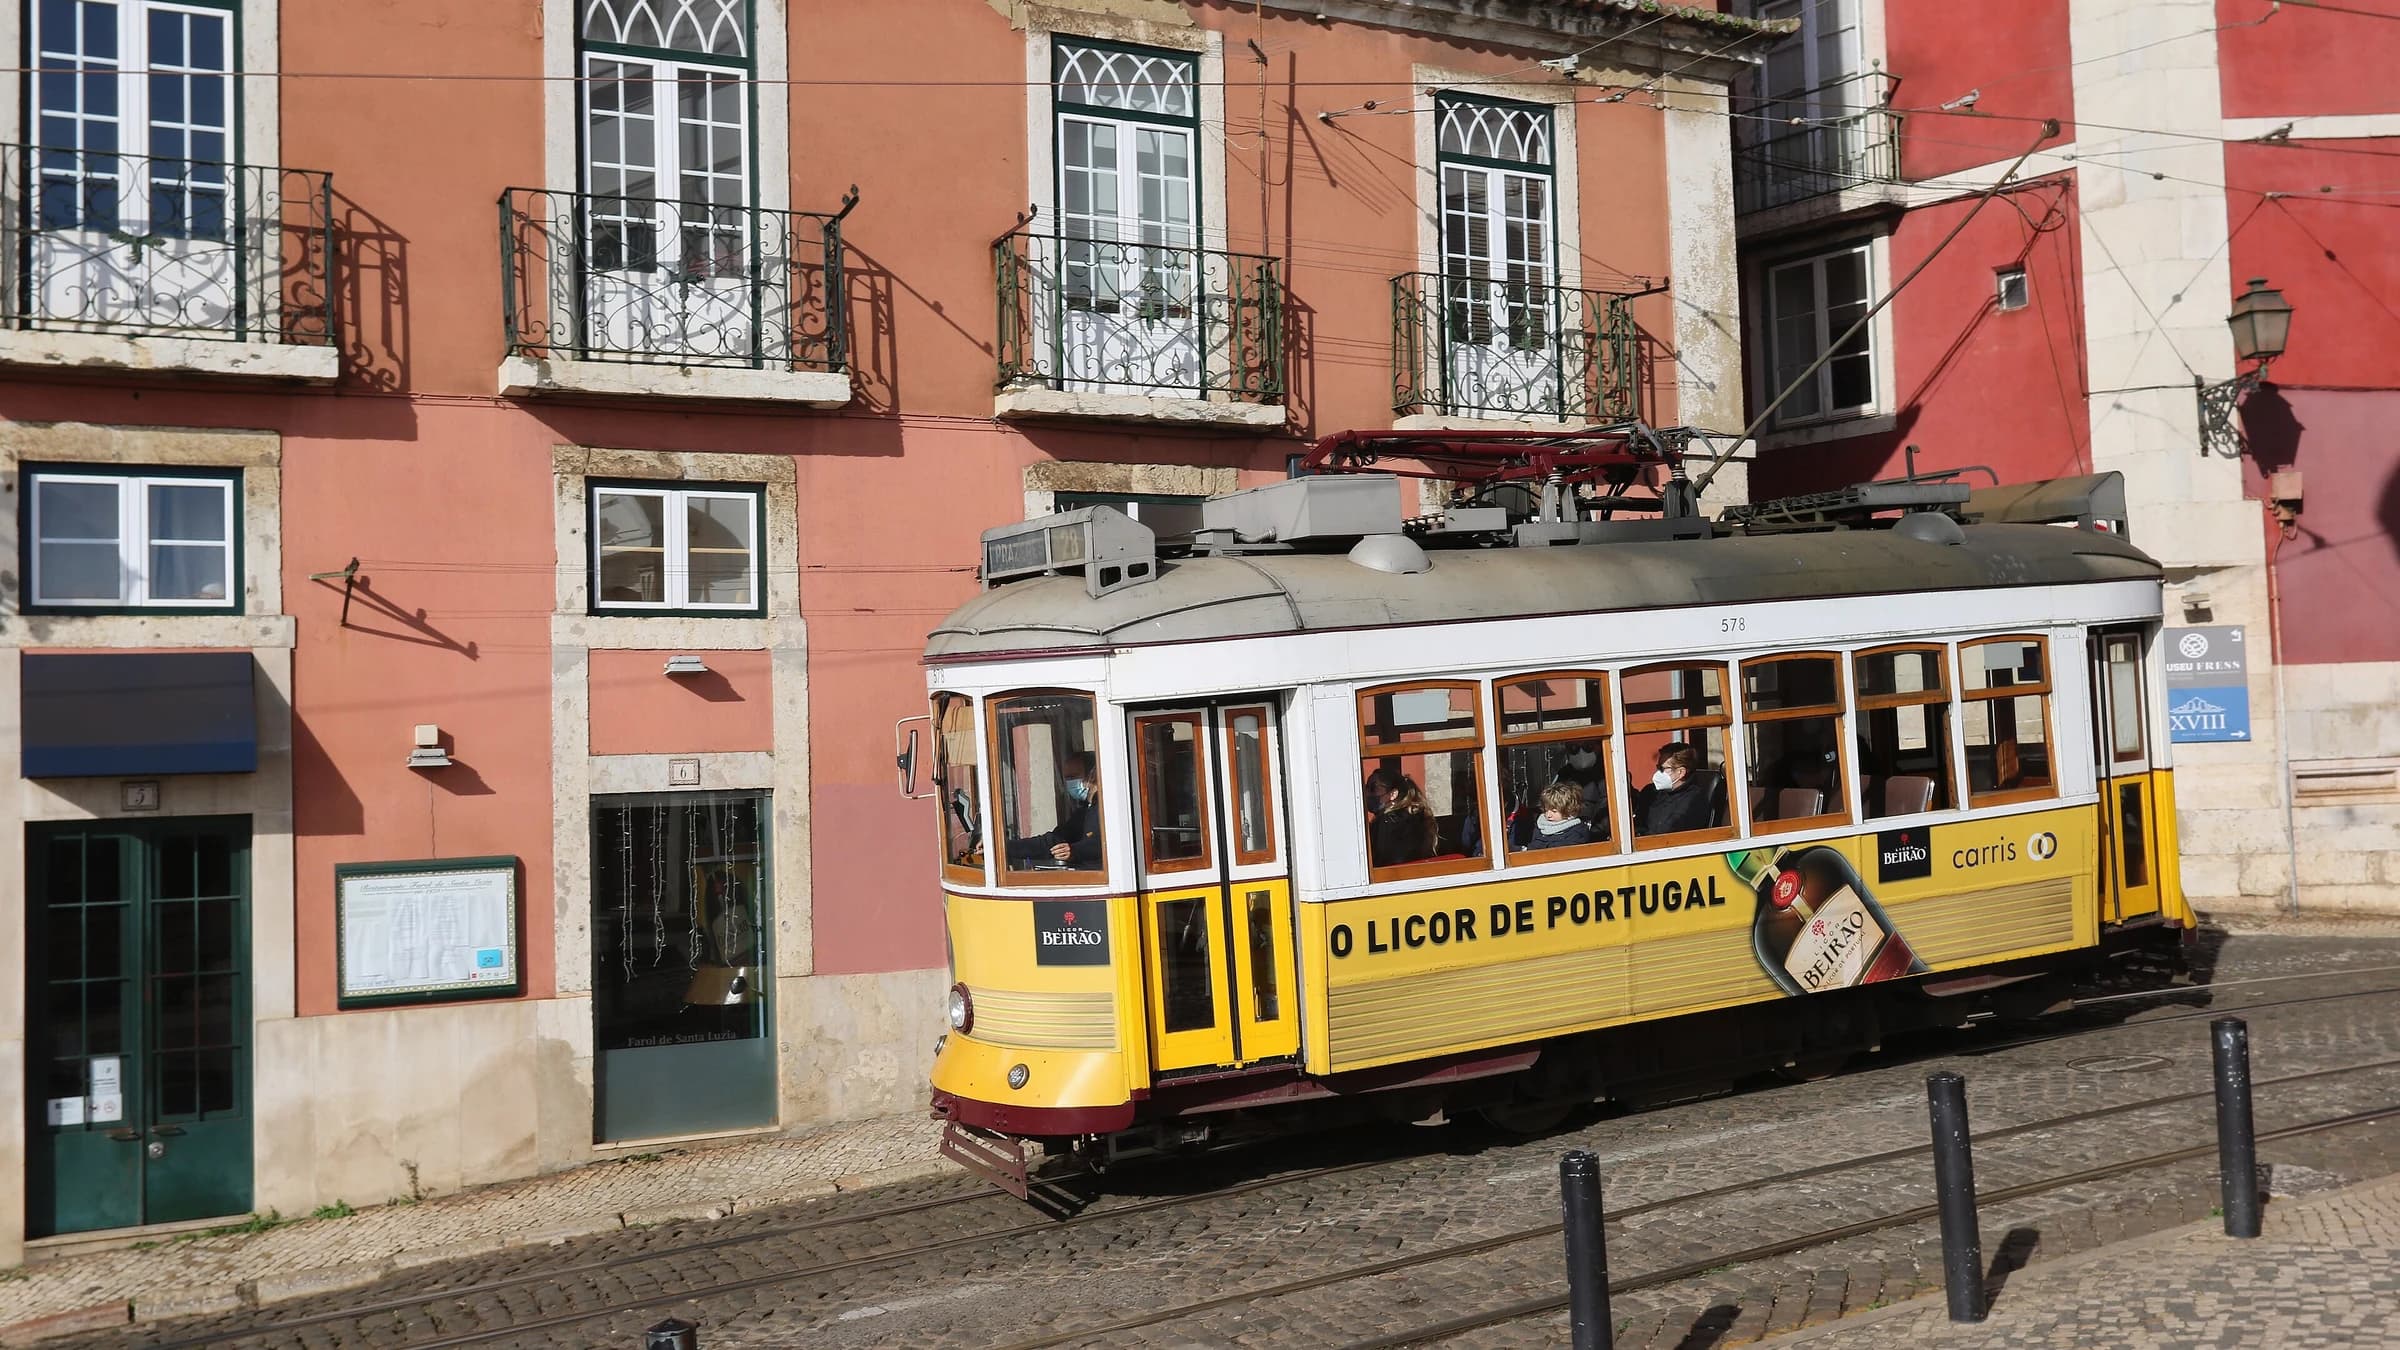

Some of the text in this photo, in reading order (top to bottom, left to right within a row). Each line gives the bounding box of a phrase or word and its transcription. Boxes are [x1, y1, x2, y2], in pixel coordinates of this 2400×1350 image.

[1721, 617, 1746, 632] 578
[2166, 662, 2193, 672] USEU
[2169, 713, 2226, 731] XVIII
[680, 765, 687, 780] 6
[1883, 847, 1926, 865] BEIRÃO
[1952, 836, 2017, 869] carris
[1330, 875, 1726, 957] O LICOR DE PORTUGAL
[1042, 930, 1102, 946] BEIRÃO
[1803, 911, 1864, 989] BEIRÃO
[628, 1030, 736, 1047] Farol de Santa Luzia
